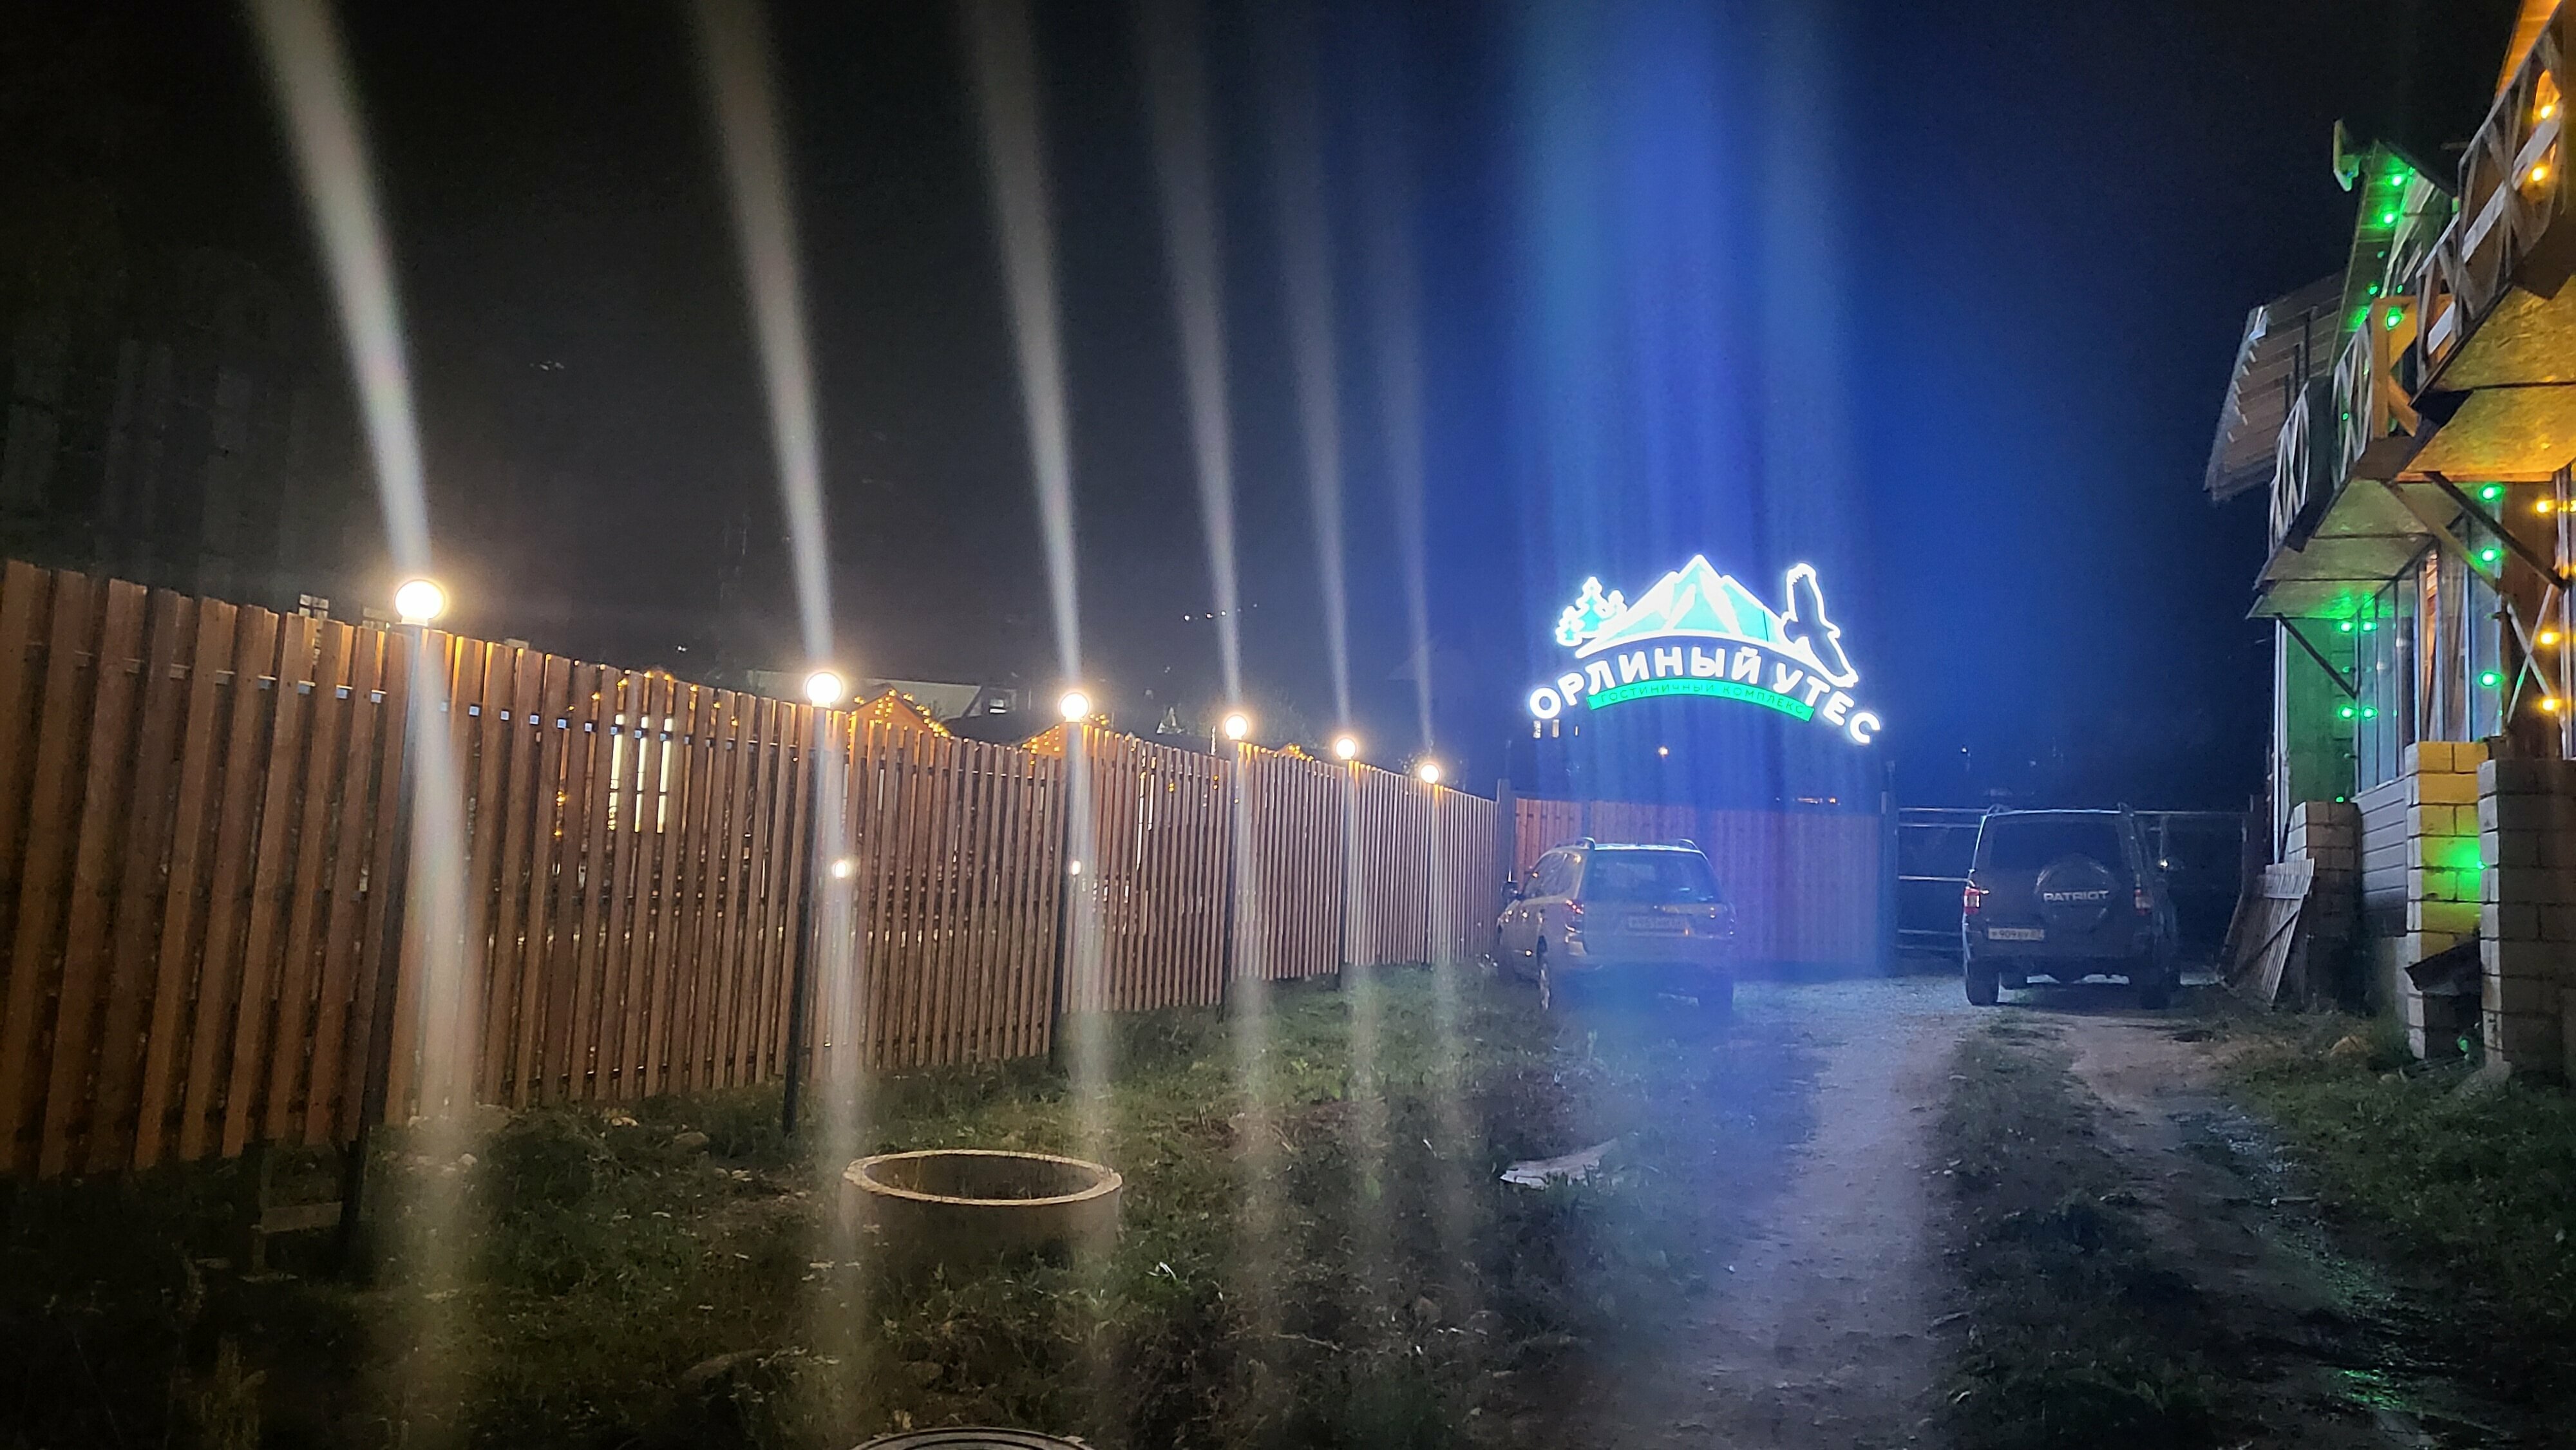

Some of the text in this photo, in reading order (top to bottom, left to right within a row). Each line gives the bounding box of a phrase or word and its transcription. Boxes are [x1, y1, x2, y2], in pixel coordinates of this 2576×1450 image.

[1530, 646, 1880, 743] ОРЛИНЫЙ УТЕС
[1723, 686, 1803, 714] КОМПЛЕКС
[2043, 890, 2109, 902] PATRIOT
